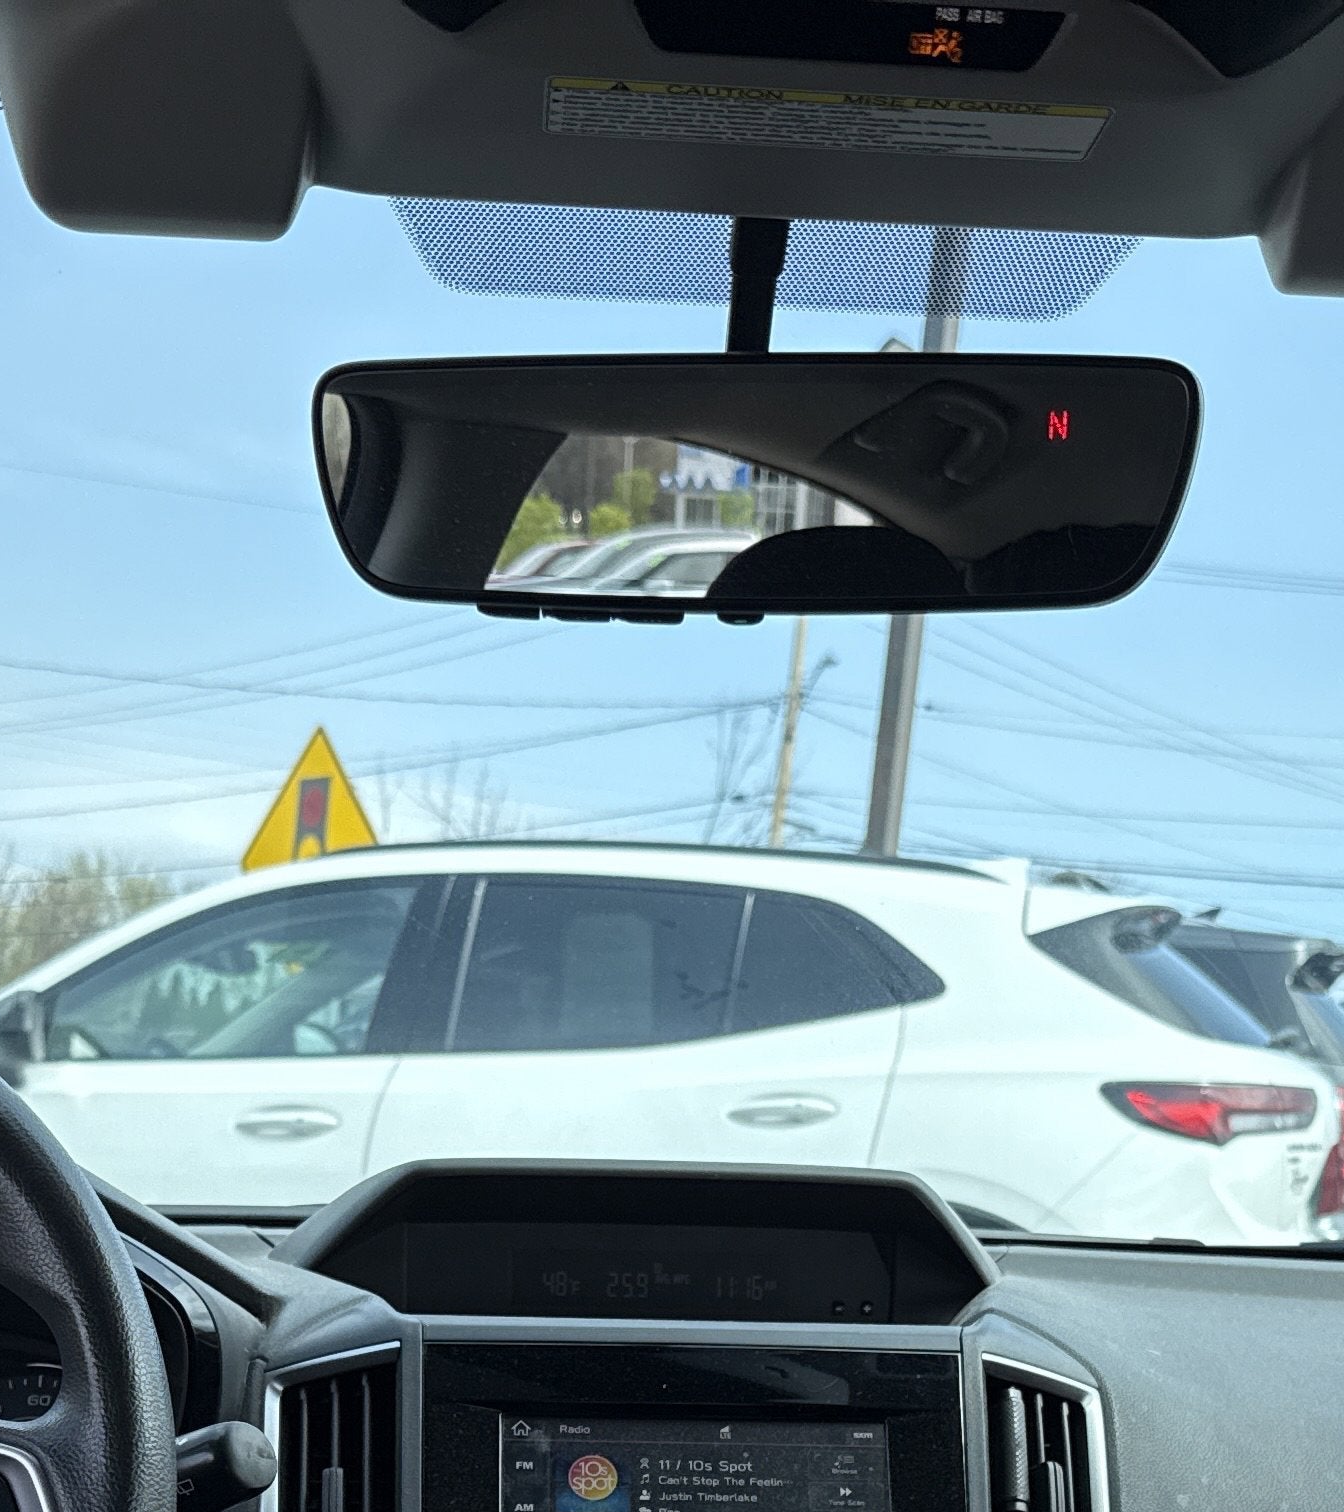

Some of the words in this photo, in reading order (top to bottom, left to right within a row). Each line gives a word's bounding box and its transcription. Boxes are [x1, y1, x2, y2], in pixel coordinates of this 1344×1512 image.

[666, 84, 784, 100] CAUTION
[843, 94, 905, 107] MISE
[915, 98, 951, 110] EN
[957, 101, 1051, 115] GARDE
[1046, 409, 1070, 441] N
[27, 1395, 51, 1407] 60
[559, 1424, 591, 1435] Radio
[516, 1461, 534, 1470] FM
[658, 1460, 670, 1470] 11
[688, 1460, 712, 1472] 10s
[719, 1461, 753, 1474] Spot
[572, 1474, 616, 1495] spot
[658, 1475, 688, 1486] Can't
[693, 1476, 720, 1488] Stop
[724, 1477, 747, 1487] The
[658, 1491, 693, 1502] Justin
[697, 1492, 758, 1503] Timberlake
[514, 1503, 534, 1512] AM
